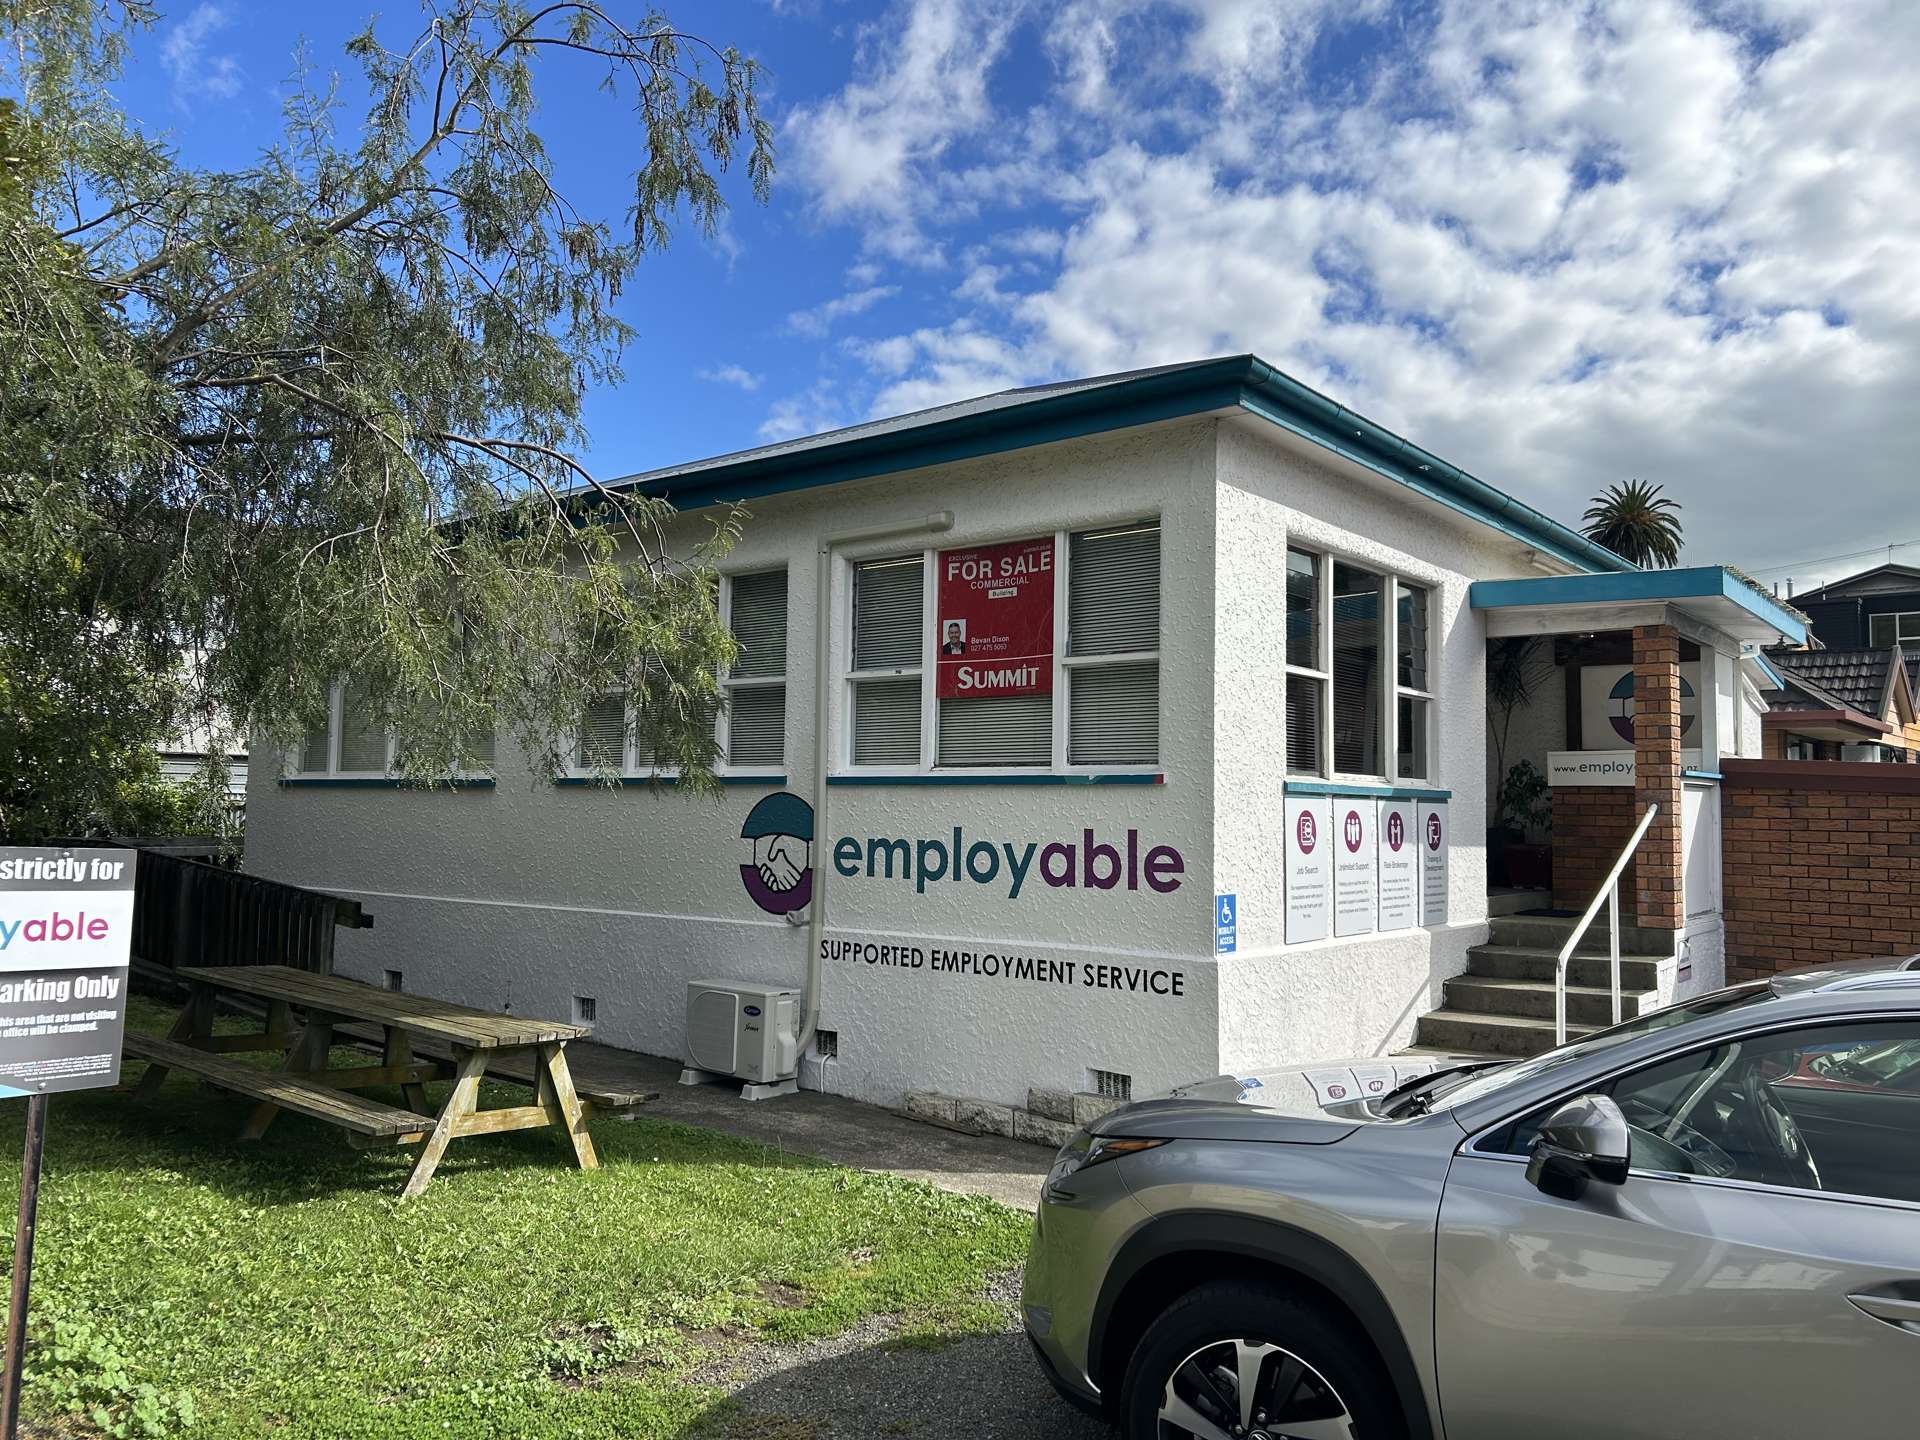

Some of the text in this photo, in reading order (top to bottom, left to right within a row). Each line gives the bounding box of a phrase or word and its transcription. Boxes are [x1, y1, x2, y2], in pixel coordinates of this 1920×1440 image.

[948, 551, 1051, 581] FOR SALE
[970, 576, 1029, 590] COMMERCIAL
[957, 664, 1040, 689] SUMMIT
[0, 857, 124, 882] strictly for
[833, 826, 1185, 899] employable
[820, 939, 1184, 996] SUPPORTED EMPLOYMENT SERVICE
[74, 975, 120, 999] Only
[14, 1015, 35, 1026] area
[36, 1014, 54, 1025] that
[54, 1013, 70, 1023] are
[71, 1012, 85, 1022] not
[86, 1009, 117, 1020] visiting
[2, 1027, 29, 1038] office
[29, 1025, 46, 1036] will
[47, 1025, 58, 1035] be
